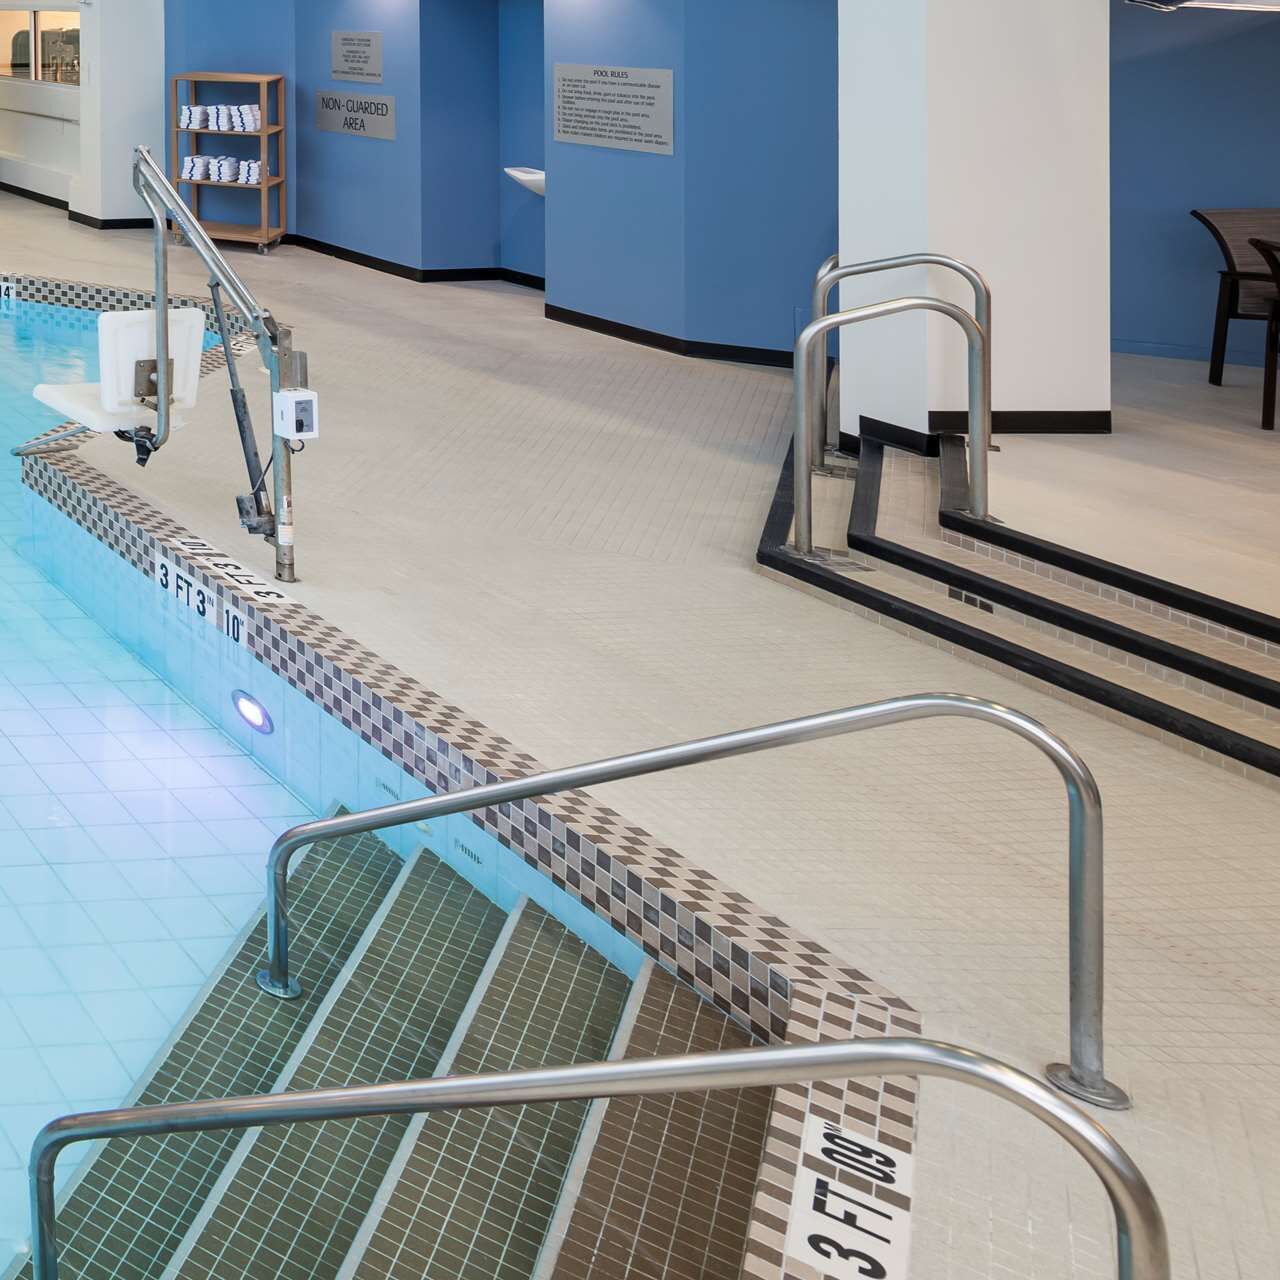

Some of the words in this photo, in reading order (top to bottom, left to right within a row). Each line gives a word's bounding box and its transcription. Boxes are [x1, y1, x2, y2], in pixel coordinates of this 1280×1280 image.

[593, 70, 609, 78] POOL
[610, 71, 628, 79] RULES
[321, 97, 389, 117] NON-GUARDED
[342, 117, 366, 131] AREA
[159, 563, 169, 590] 3
[175, 573, 193, 607] FT
[224, 571, 267, 586] FT
[252, 590, 285, 599] 3
[812, 1177, 893, 1245] FT
[807, 1233, 887, 1280] 3
